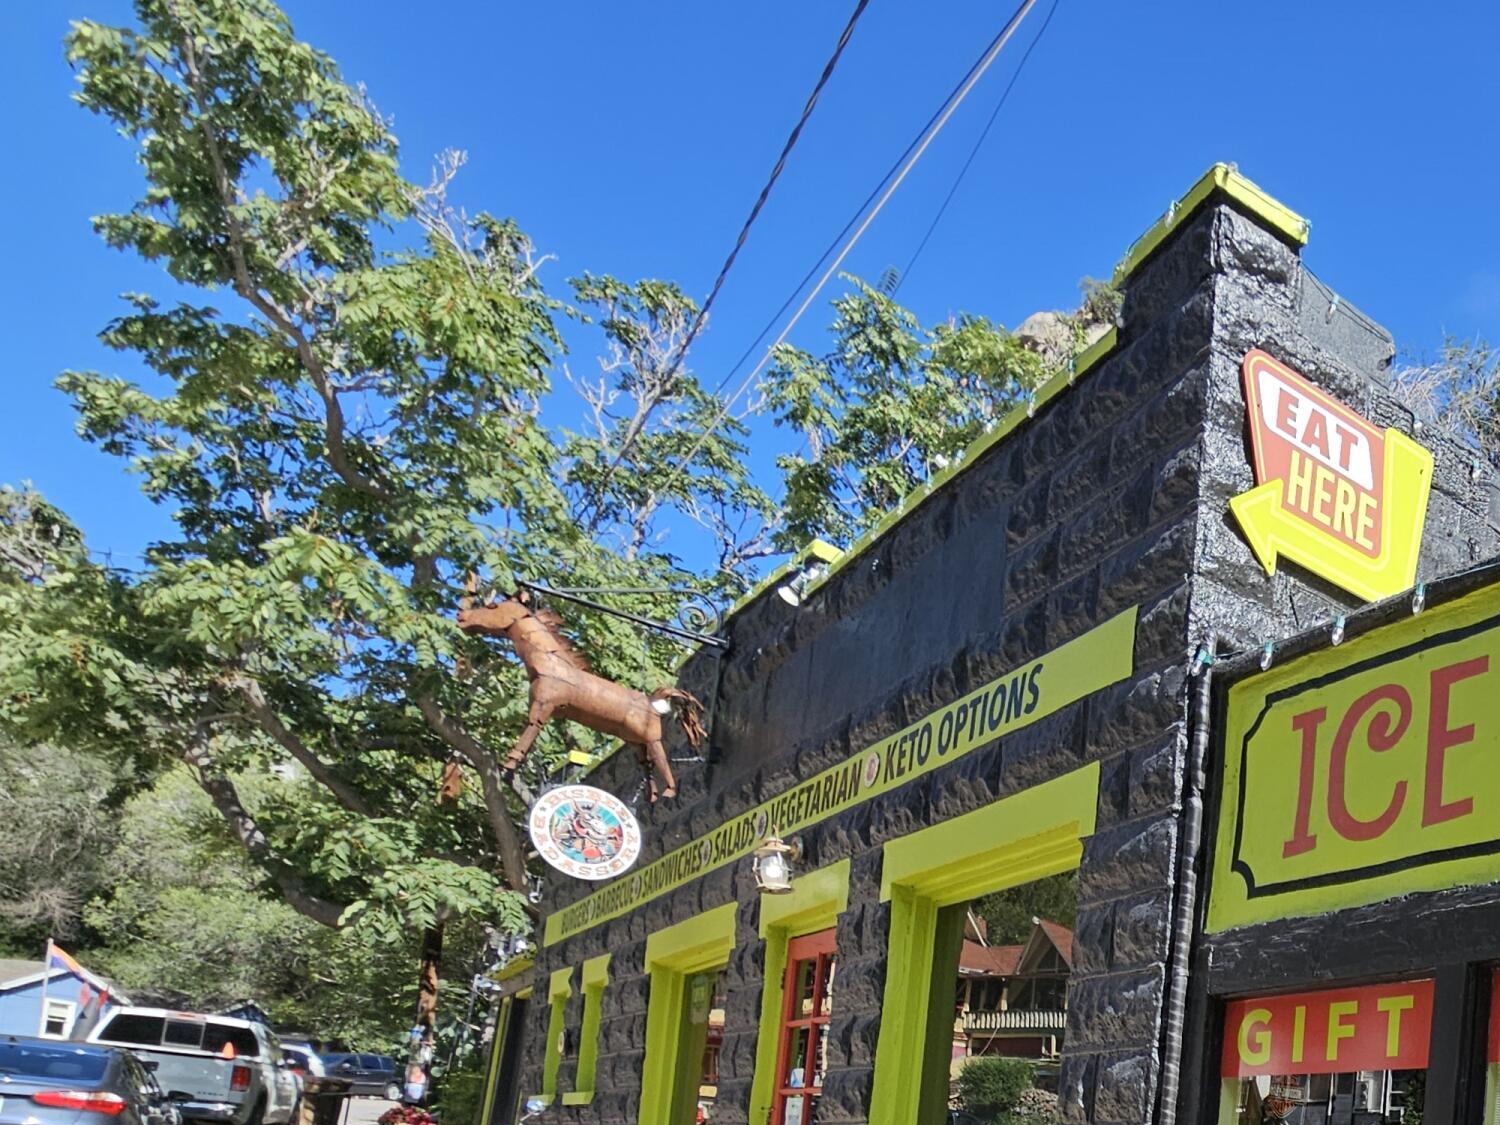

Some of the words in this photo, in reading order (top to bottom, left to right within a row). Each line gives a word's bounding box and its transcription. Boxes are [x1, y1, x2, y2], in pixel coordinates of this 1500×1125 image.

[1276, 387, 1359, 471] EAT
[1287, 450, 1378, 551] HERE
[642, 840, 703, 898] SANDWICHES
[713, 813, 757, 864] SALADS
[770, 759, 863, 833] VEGETARIAN
[884, 723, 932, 784] KETO
[938, 663, 1043, 756] OPTIONS
[1282, 655, 1490, 858] ICE
[1237, 995, 1415, 1066] GIFT
